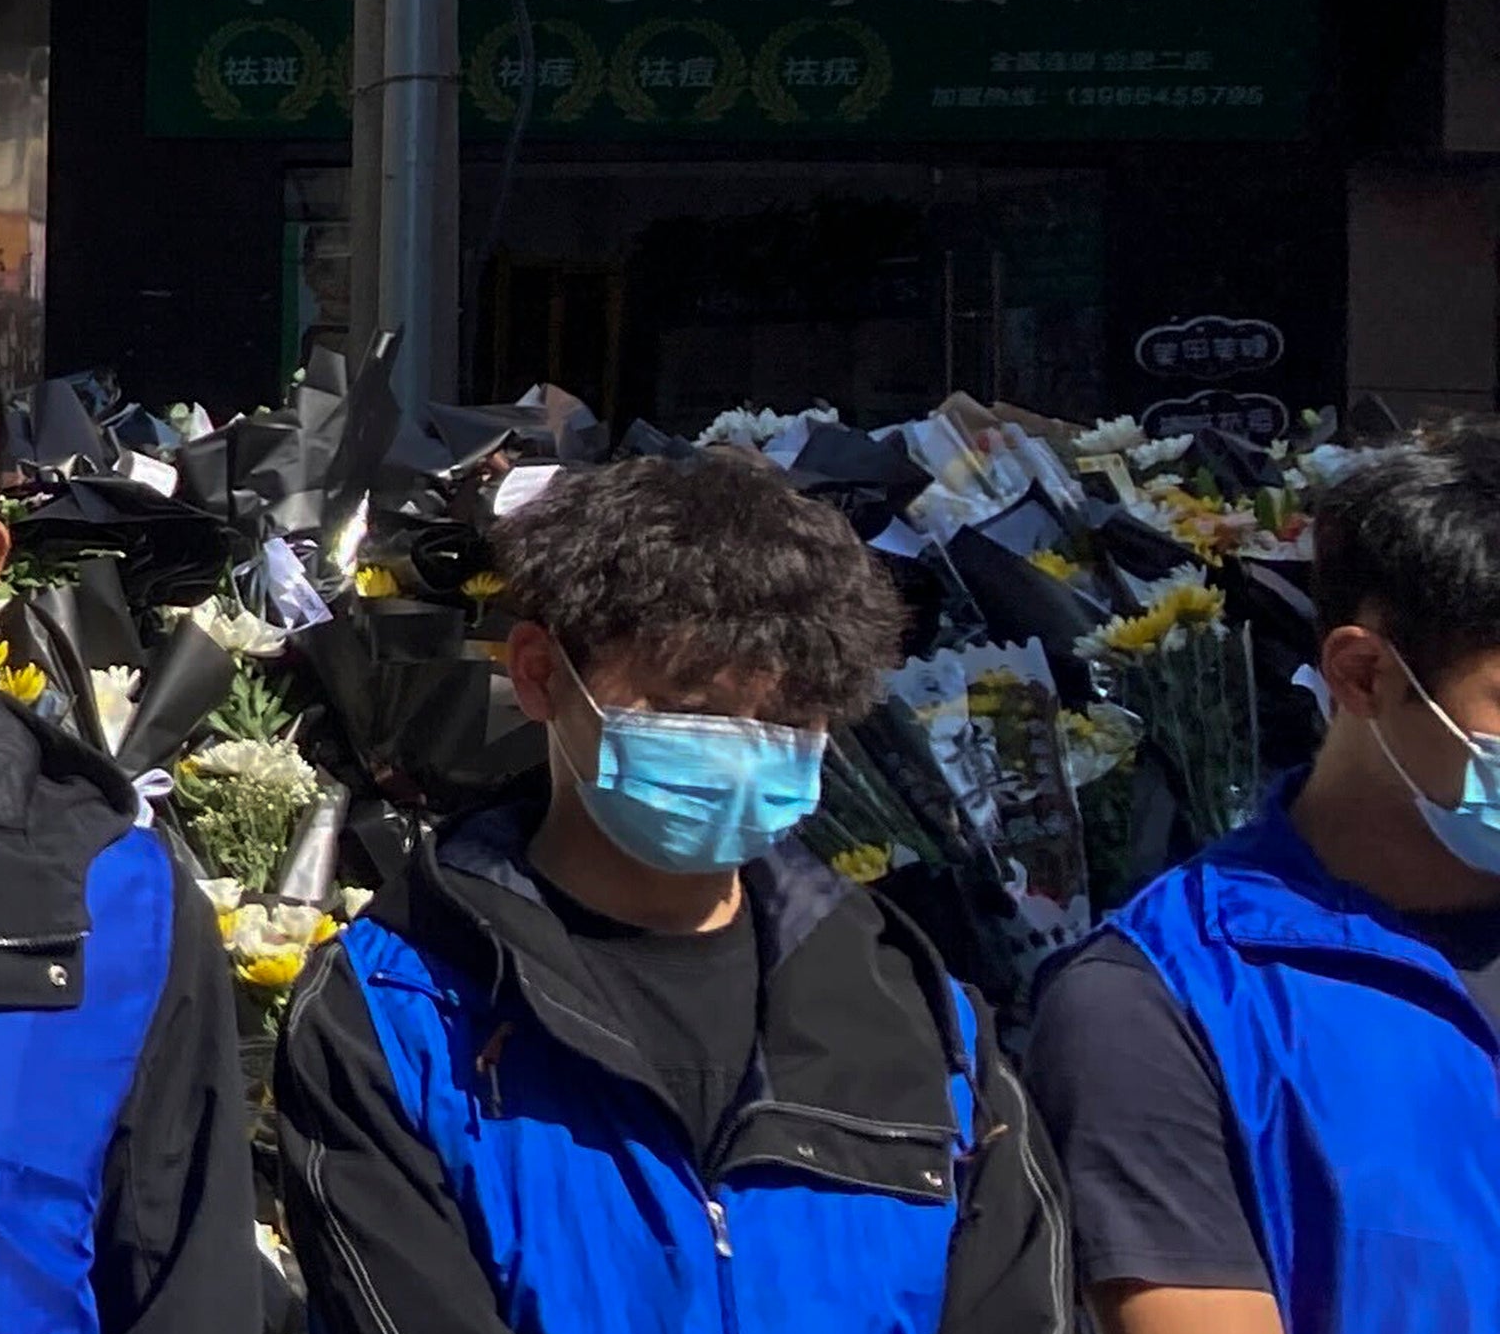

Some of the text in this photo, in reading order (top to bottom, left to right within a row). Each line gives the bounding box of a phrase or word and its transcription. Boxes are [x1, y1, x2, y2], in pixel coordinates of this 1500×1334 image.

[223, 55, 299, 87] 祛斑
[638, 55, 717, 88] 祛痘
[784, 54, 859, 87] 祛疣
